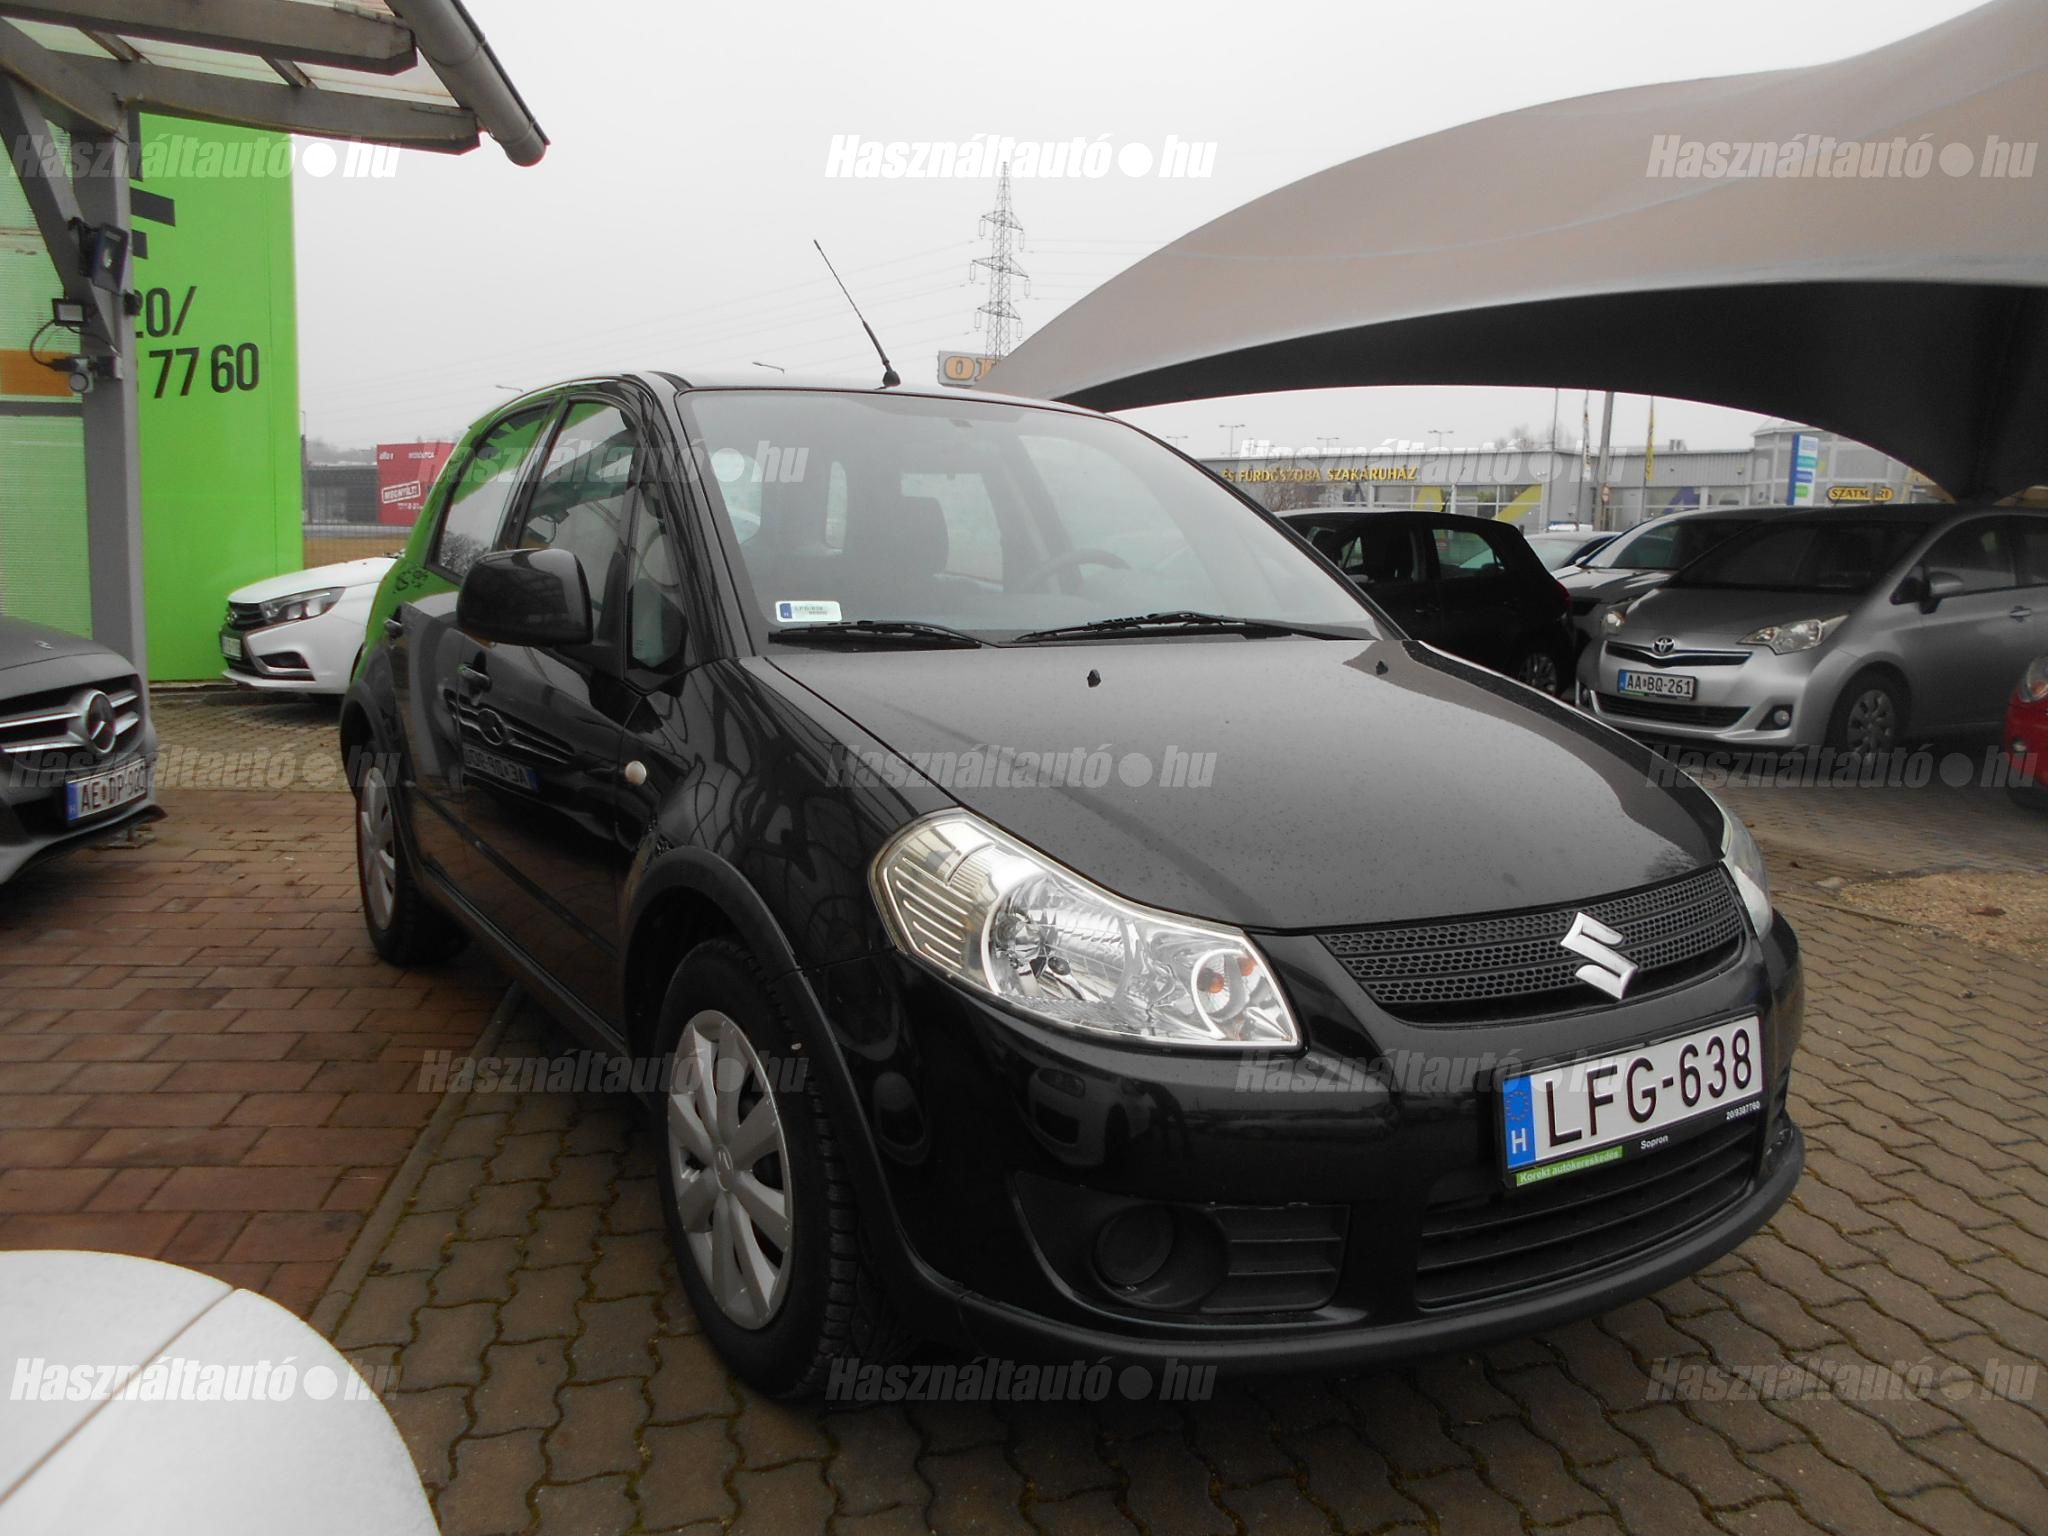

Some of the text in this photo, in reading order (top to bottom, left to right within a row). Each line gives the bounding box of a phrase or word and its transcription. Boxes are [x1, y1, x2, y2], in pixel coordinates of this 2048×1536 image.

[210, 342, 259, 393] 60
[1327, 464, 1418, 481] SZAKÁRUHÁZ
[1831, 488, 1890, 499] SZATMRI
[1511, 1028, 1752, 1154] H LFG-638
[1641, 1135, 1669, 1150] Sopron
